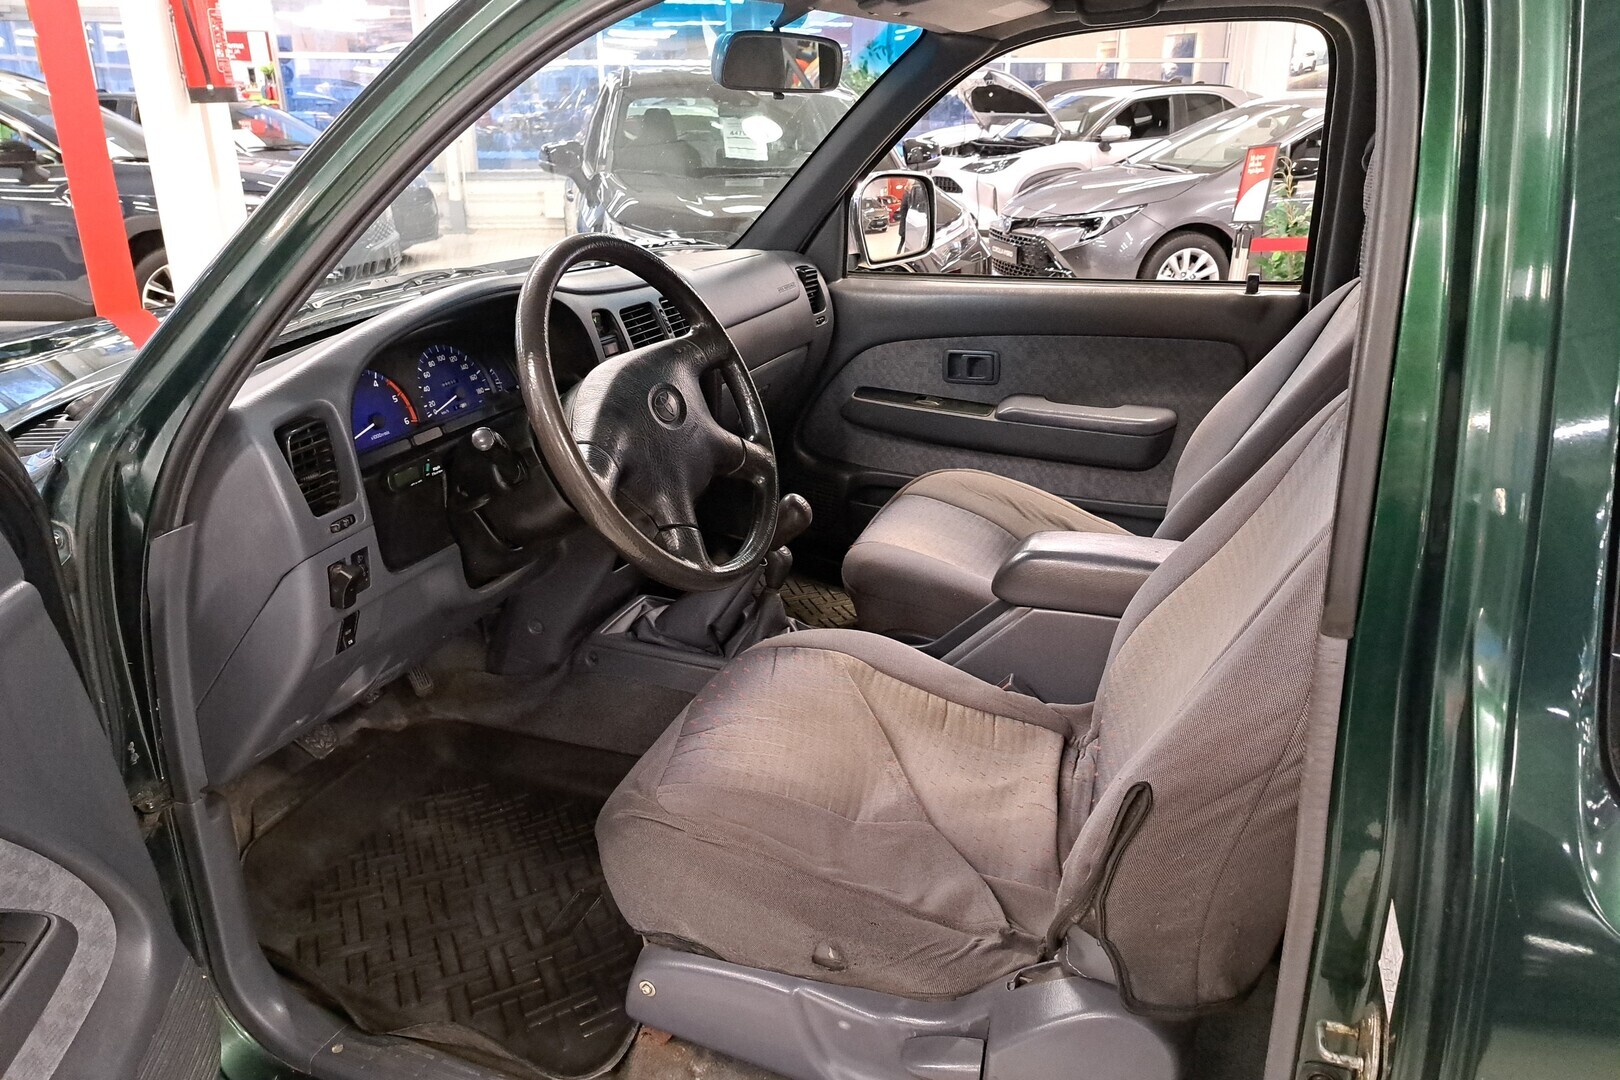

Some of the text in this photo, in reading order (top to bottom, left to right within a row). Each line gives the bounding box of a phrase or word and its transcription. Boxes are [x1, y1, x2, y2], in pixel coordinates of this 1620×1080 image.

[436, 354, 446, 362] 100
[428, 360, 436, 368] 80
[423, 371, 431, 379] 60
[373, 380, 379, 388] 4
[423, 385, 431, 393] 40
[392, 395, 399, 403] 5
[428, 400, 436, 408] 20
[404, 417, 410, 425] 6
